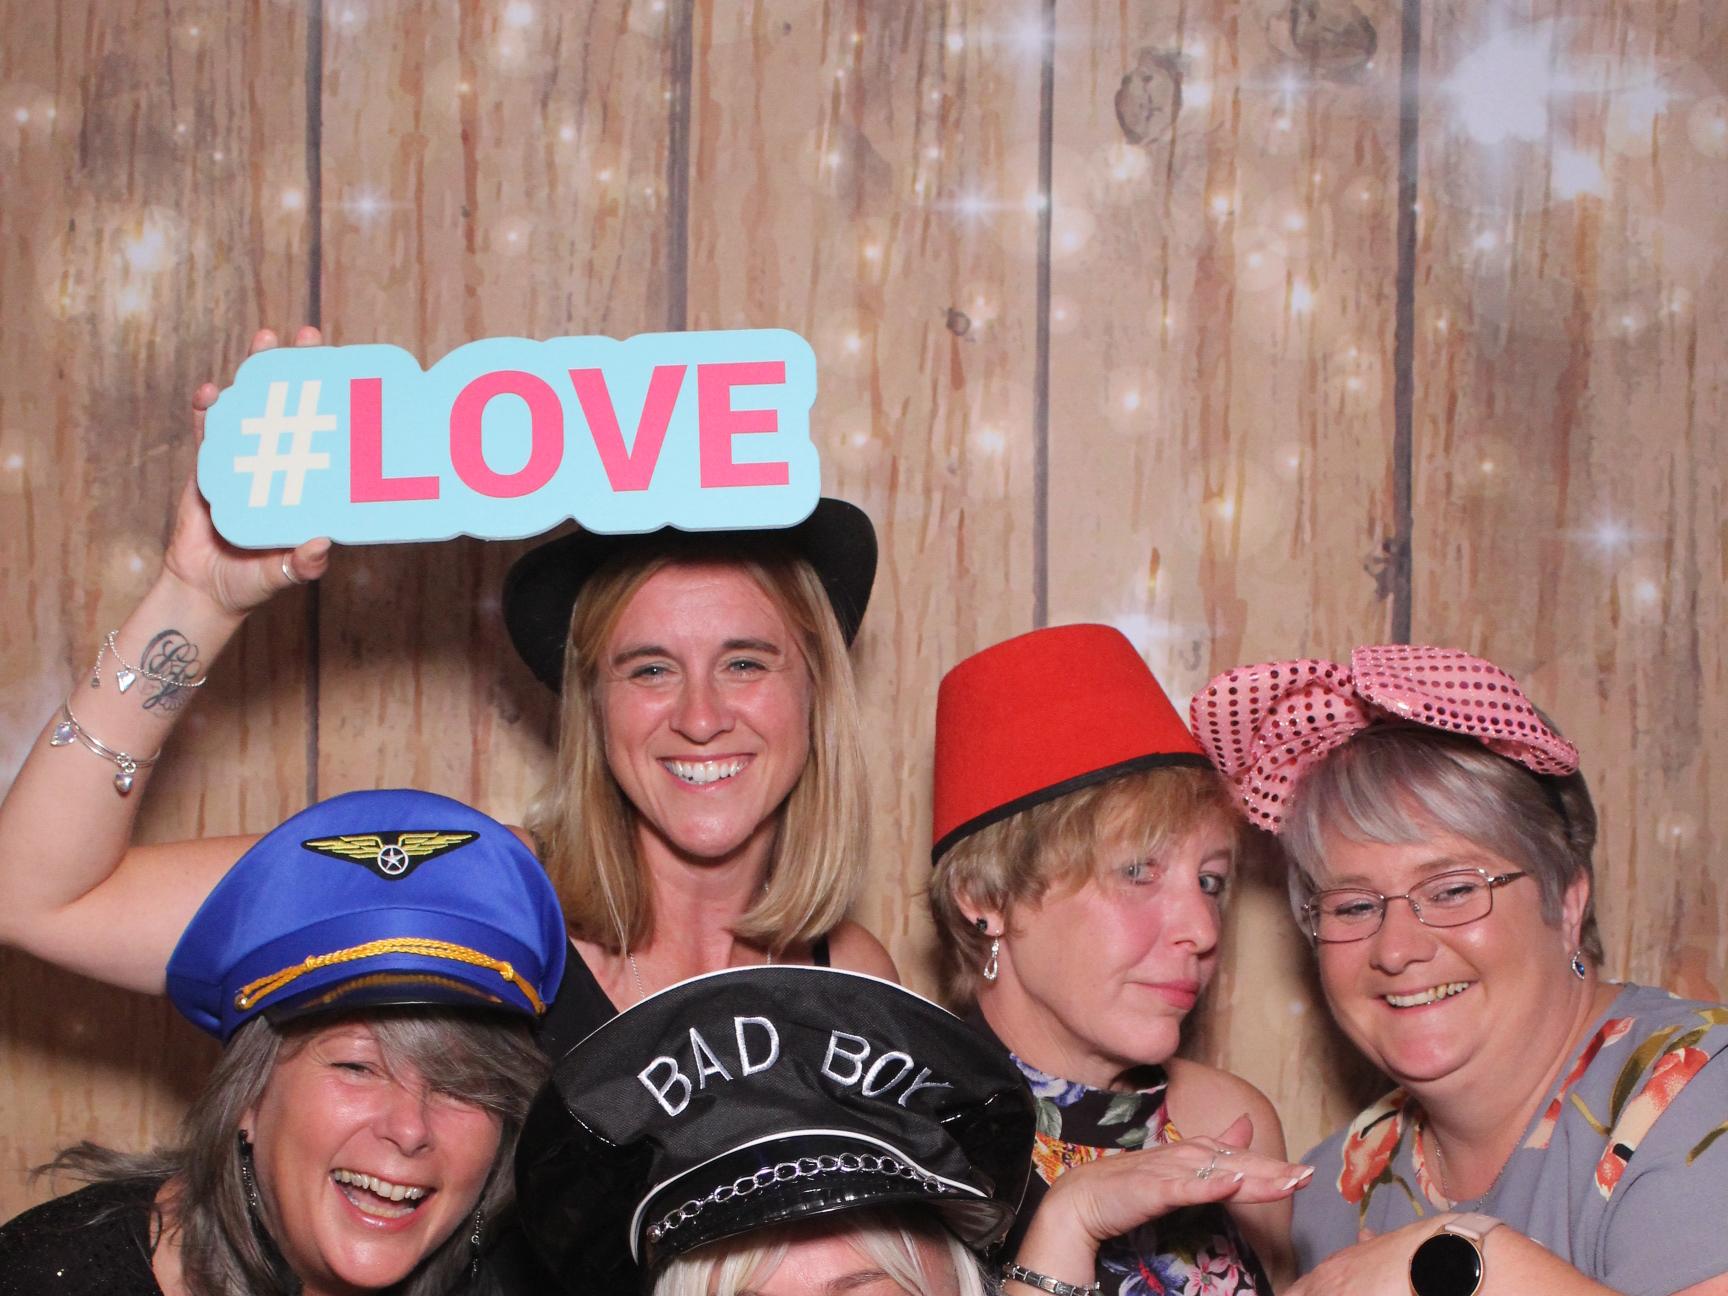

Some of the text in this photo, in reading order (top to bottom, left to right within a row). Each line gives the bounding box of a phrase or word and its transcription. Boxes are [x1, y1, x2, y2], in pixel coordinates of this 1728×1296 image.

[233, 361, 790, 507] #LOVE
[636, 1016, 954, 1116] BAD BOY
